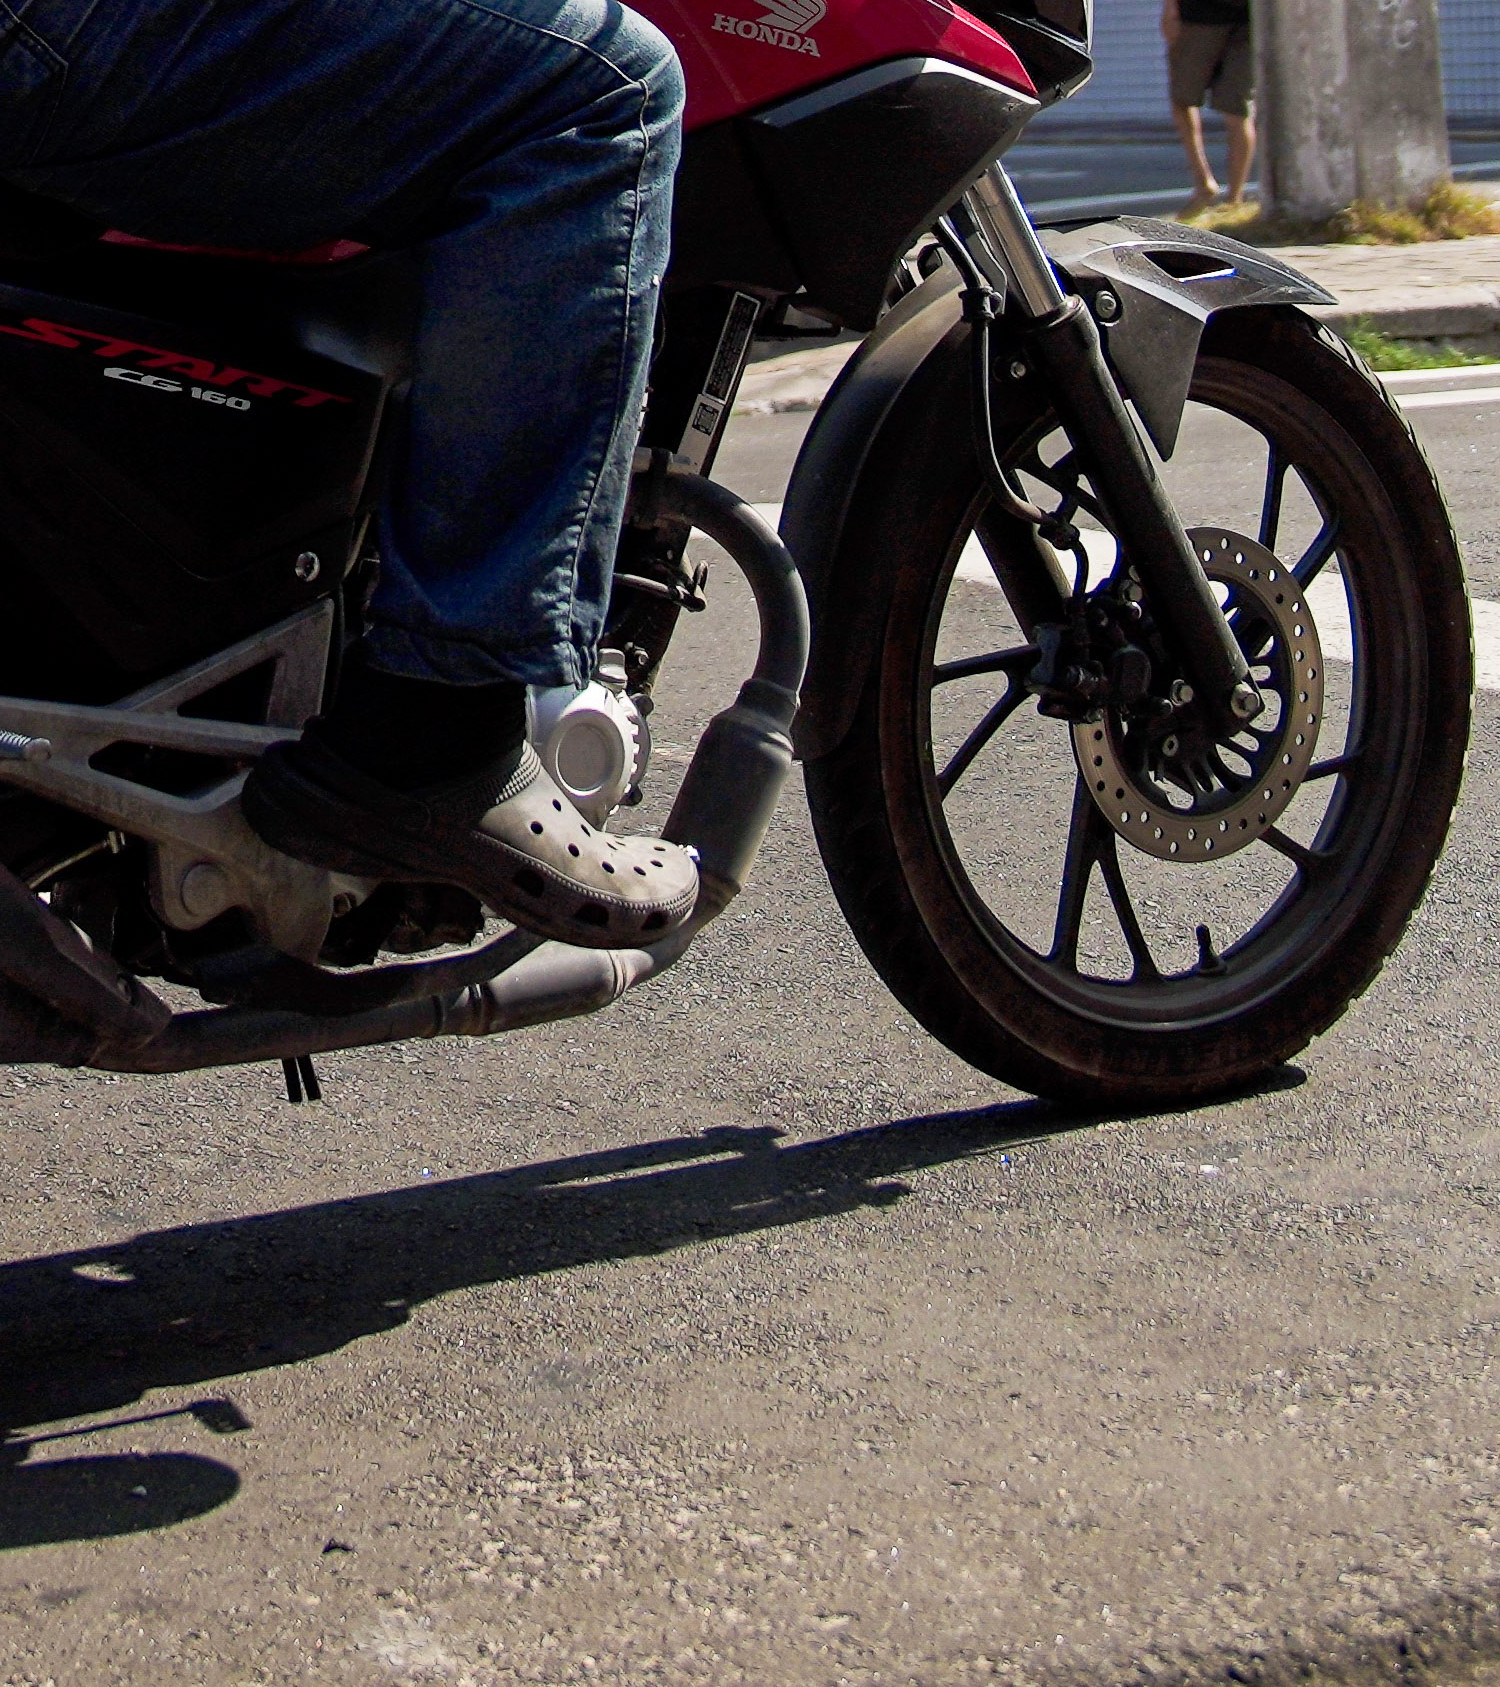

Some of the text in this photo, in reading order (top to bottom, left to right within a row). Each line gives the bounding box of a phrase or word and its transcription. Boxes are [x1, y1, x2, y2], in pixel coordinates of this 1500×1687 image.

[711, 13, 821, 58] HONDA
[104, 367, 251, 411] CG 160
